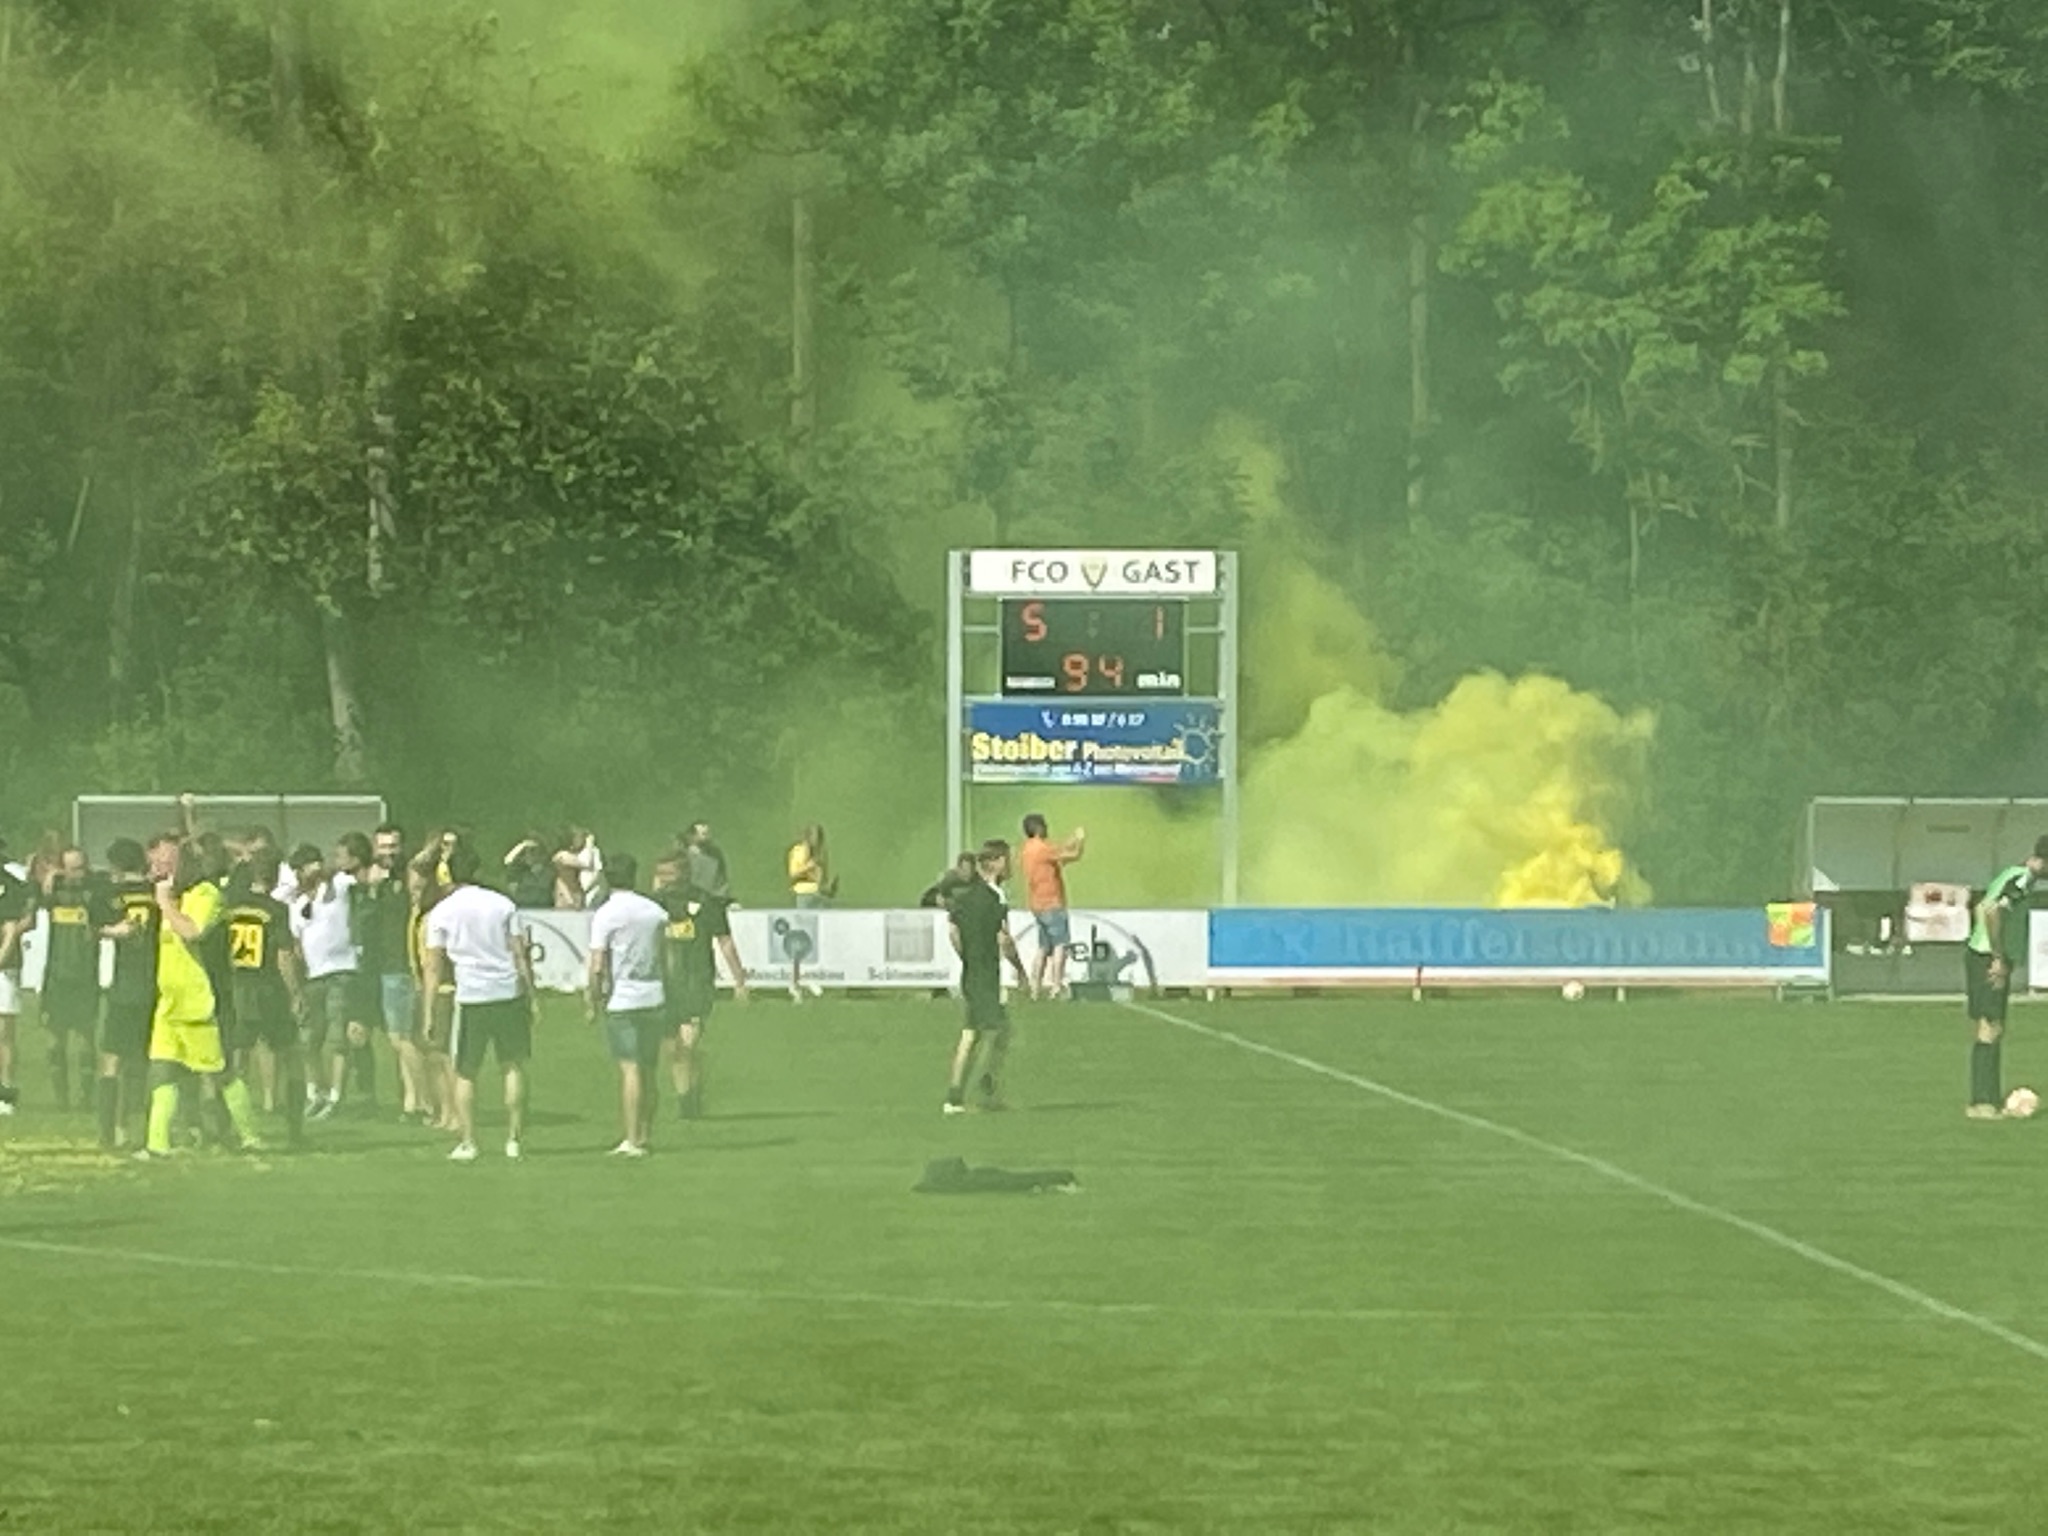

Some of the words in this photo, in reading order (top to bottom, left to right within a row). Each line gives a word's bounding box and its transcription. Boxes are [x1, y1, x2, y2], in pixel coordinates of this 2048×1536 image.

[1011, 560, 1069, 583] FCO
[1122, 560, 1201, 583] GAST
[1062, 653, 1125, 692] 94
[1136, 671, 1182, 689] min
[972, 732, 1078, 761] Stoiber
